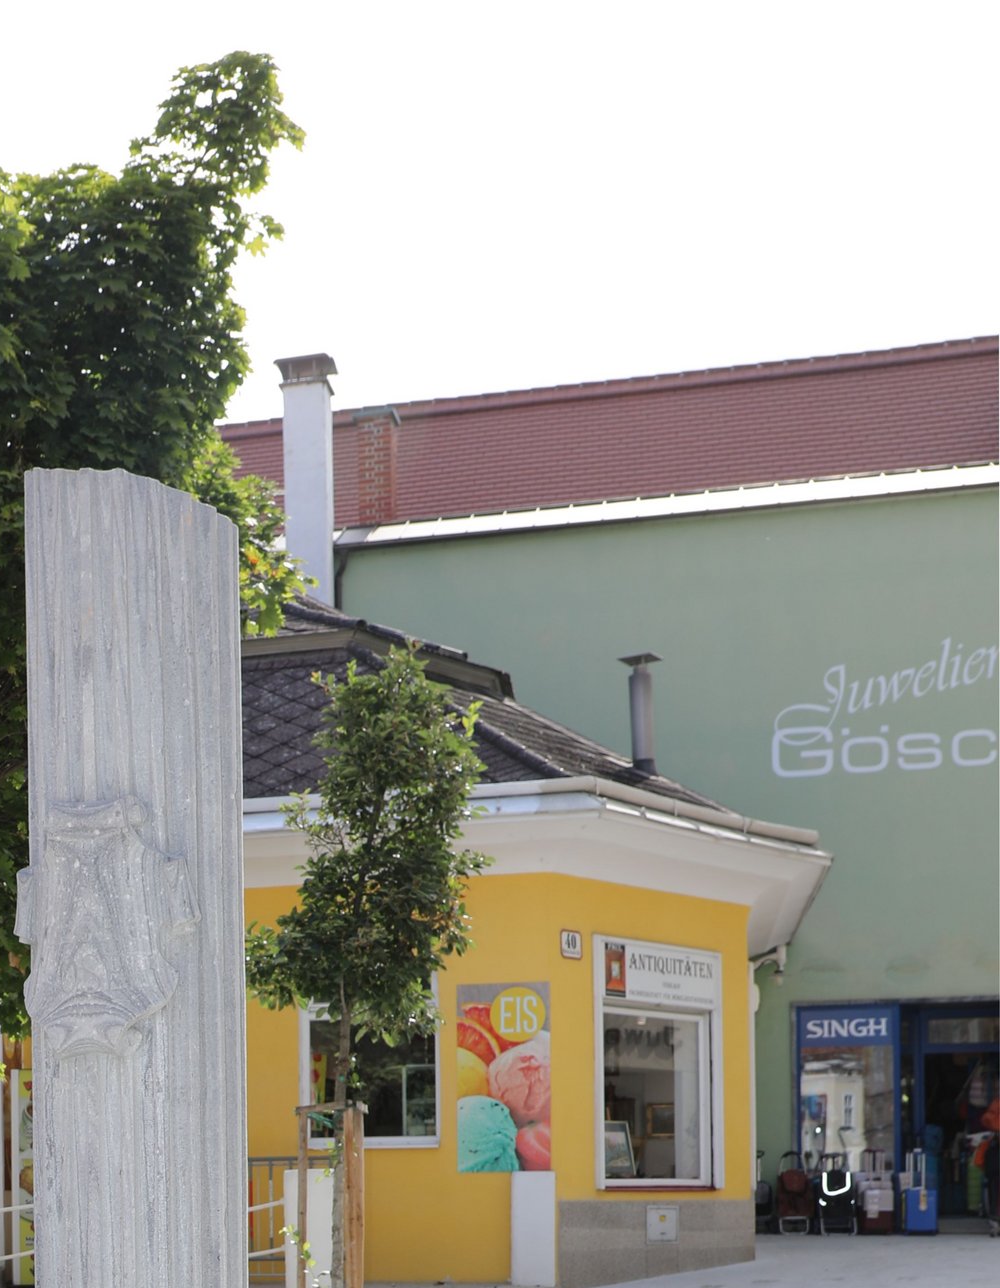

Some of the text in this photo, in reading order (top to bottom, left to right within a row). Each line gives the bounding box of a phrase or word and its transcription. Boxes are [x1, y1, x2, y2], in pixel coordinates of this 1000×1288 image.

[775, 637, 999, 742] Juwelier
[565, 932, 577, 949] 40
[629, 952, 713, 979] ANTIQUITÄTEN
[500, 995, 537, 1033] EIS
[806, 1017, 888, 1039] SINGH
